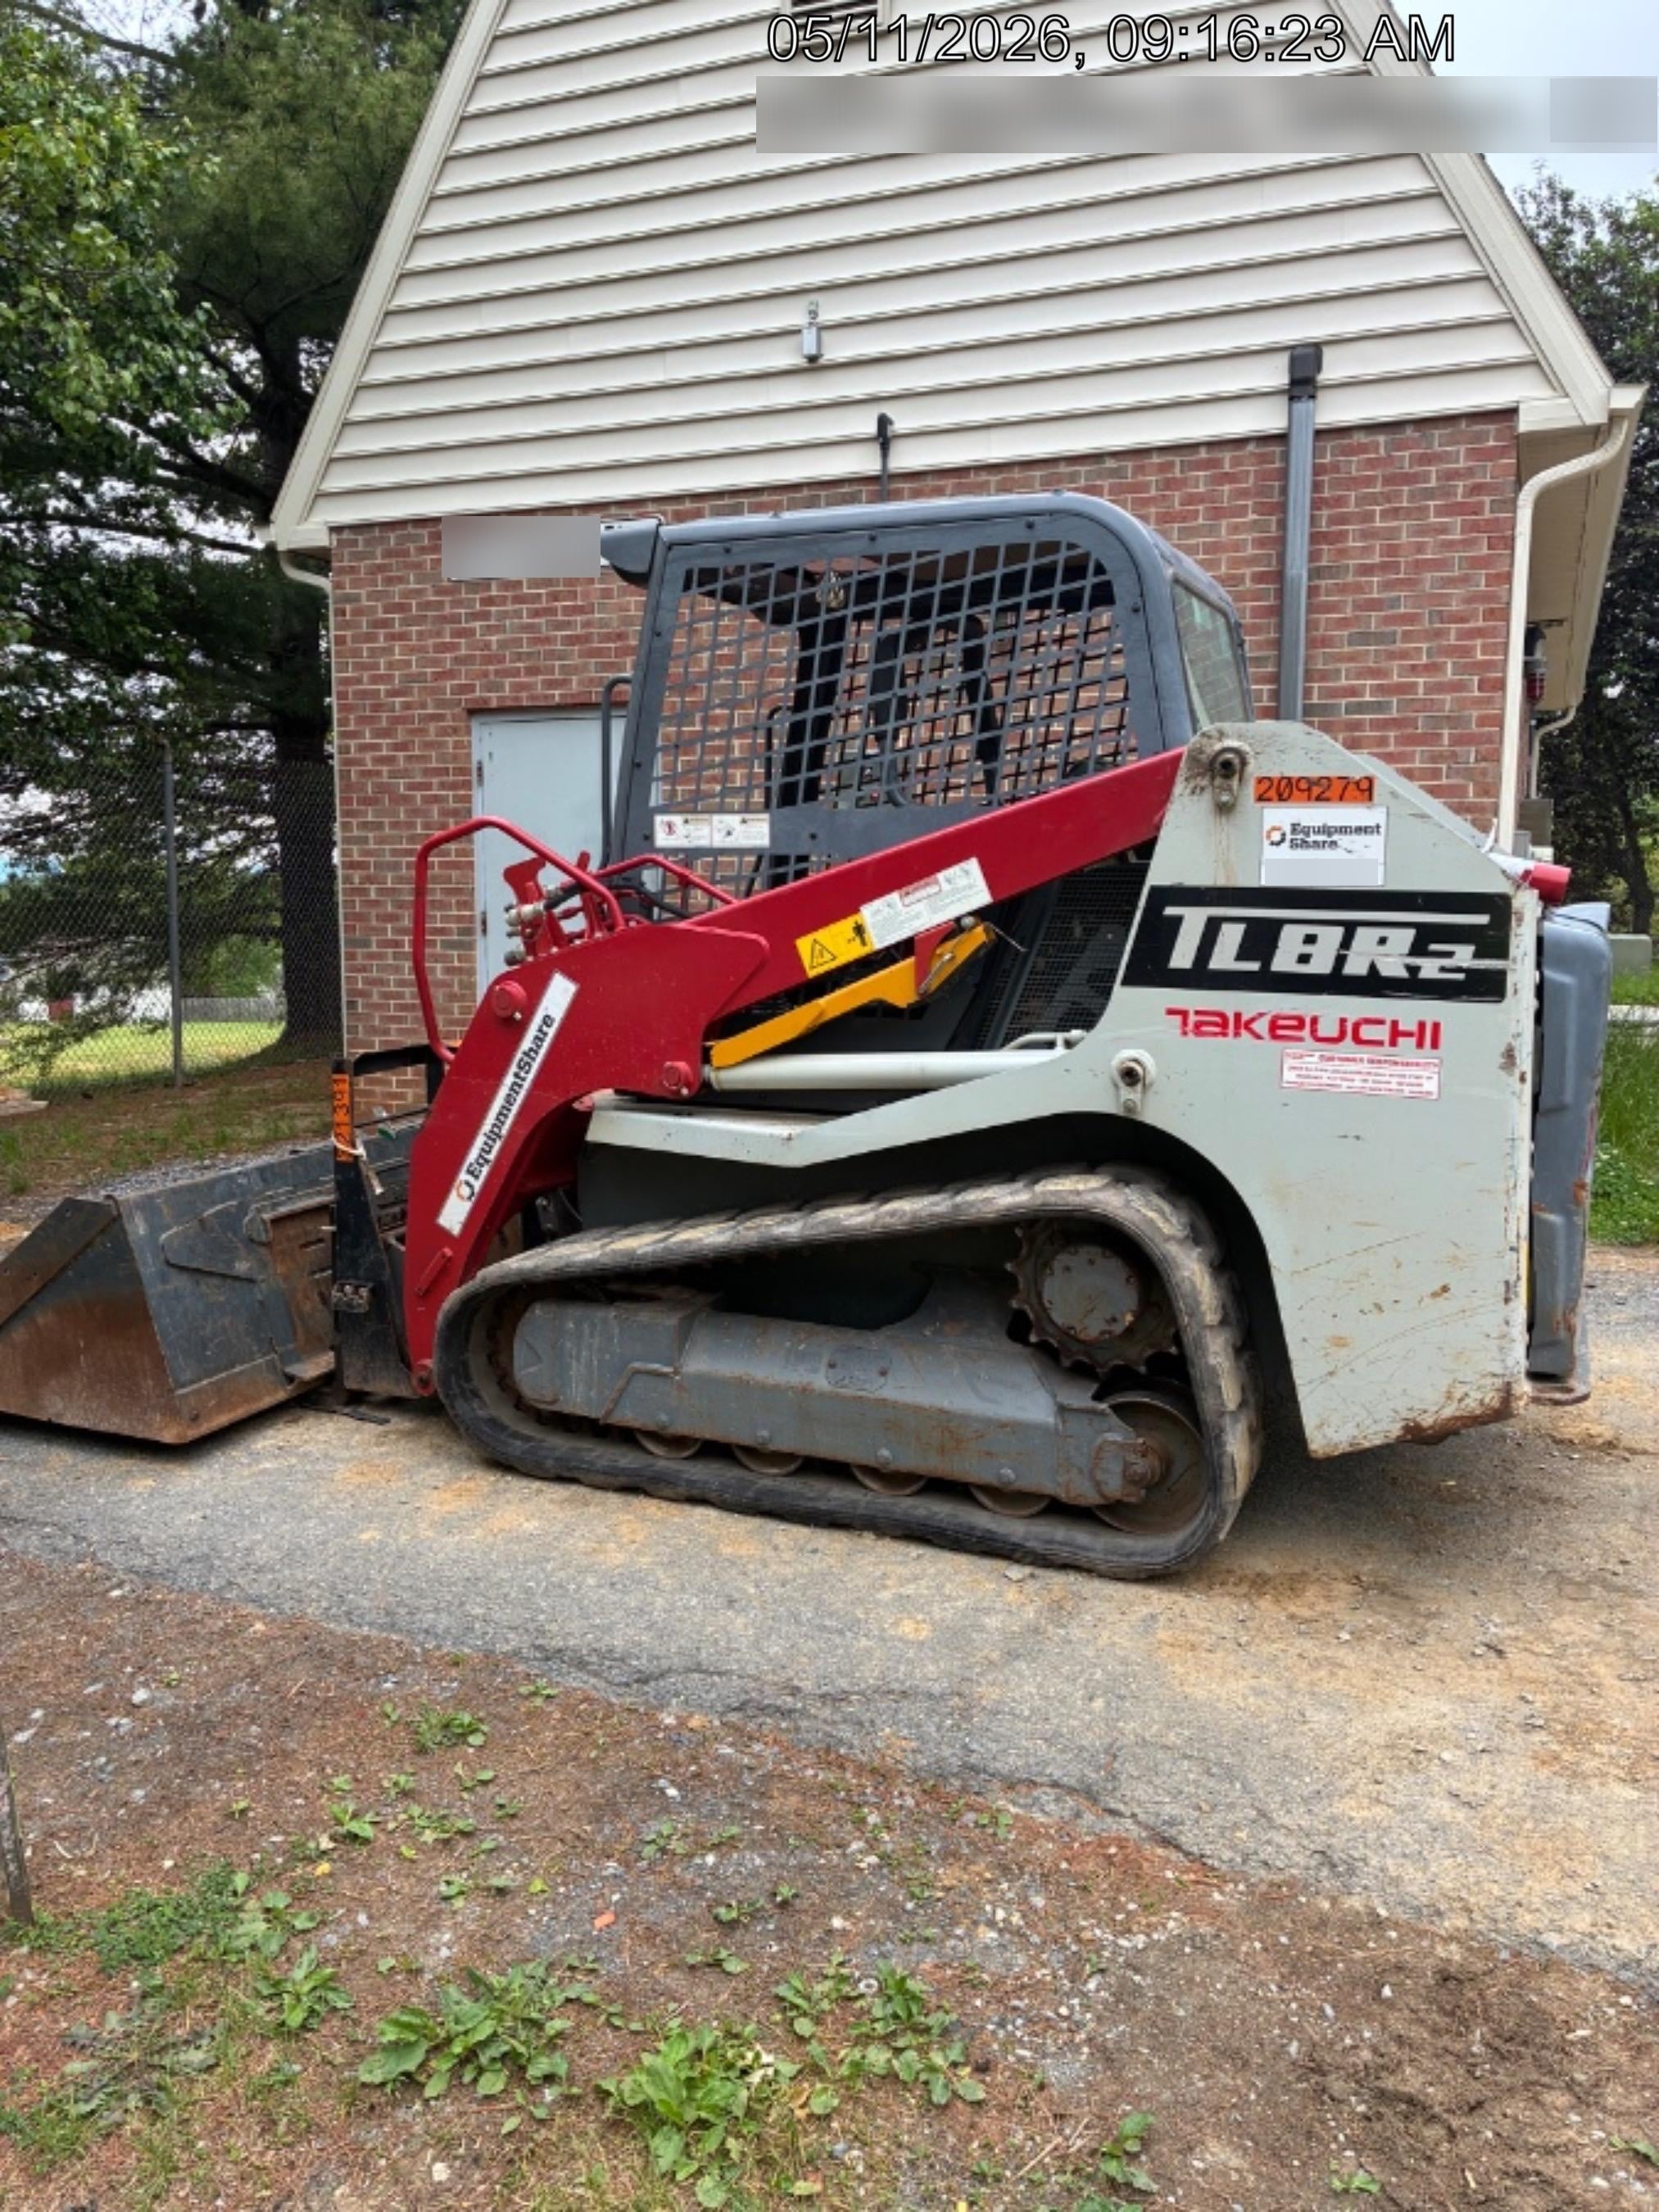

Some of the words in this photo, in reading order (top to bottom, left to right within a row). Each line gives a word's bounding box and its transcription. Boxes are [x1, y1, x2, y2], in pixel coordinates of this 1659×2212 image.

[1254, 776, 1373, 802] 209279
[1290, 822, 1382, 838] Equipment
[1290, 837, 1339, 850] Share
[465, 1013, 555, 1181] EquipmentShare
